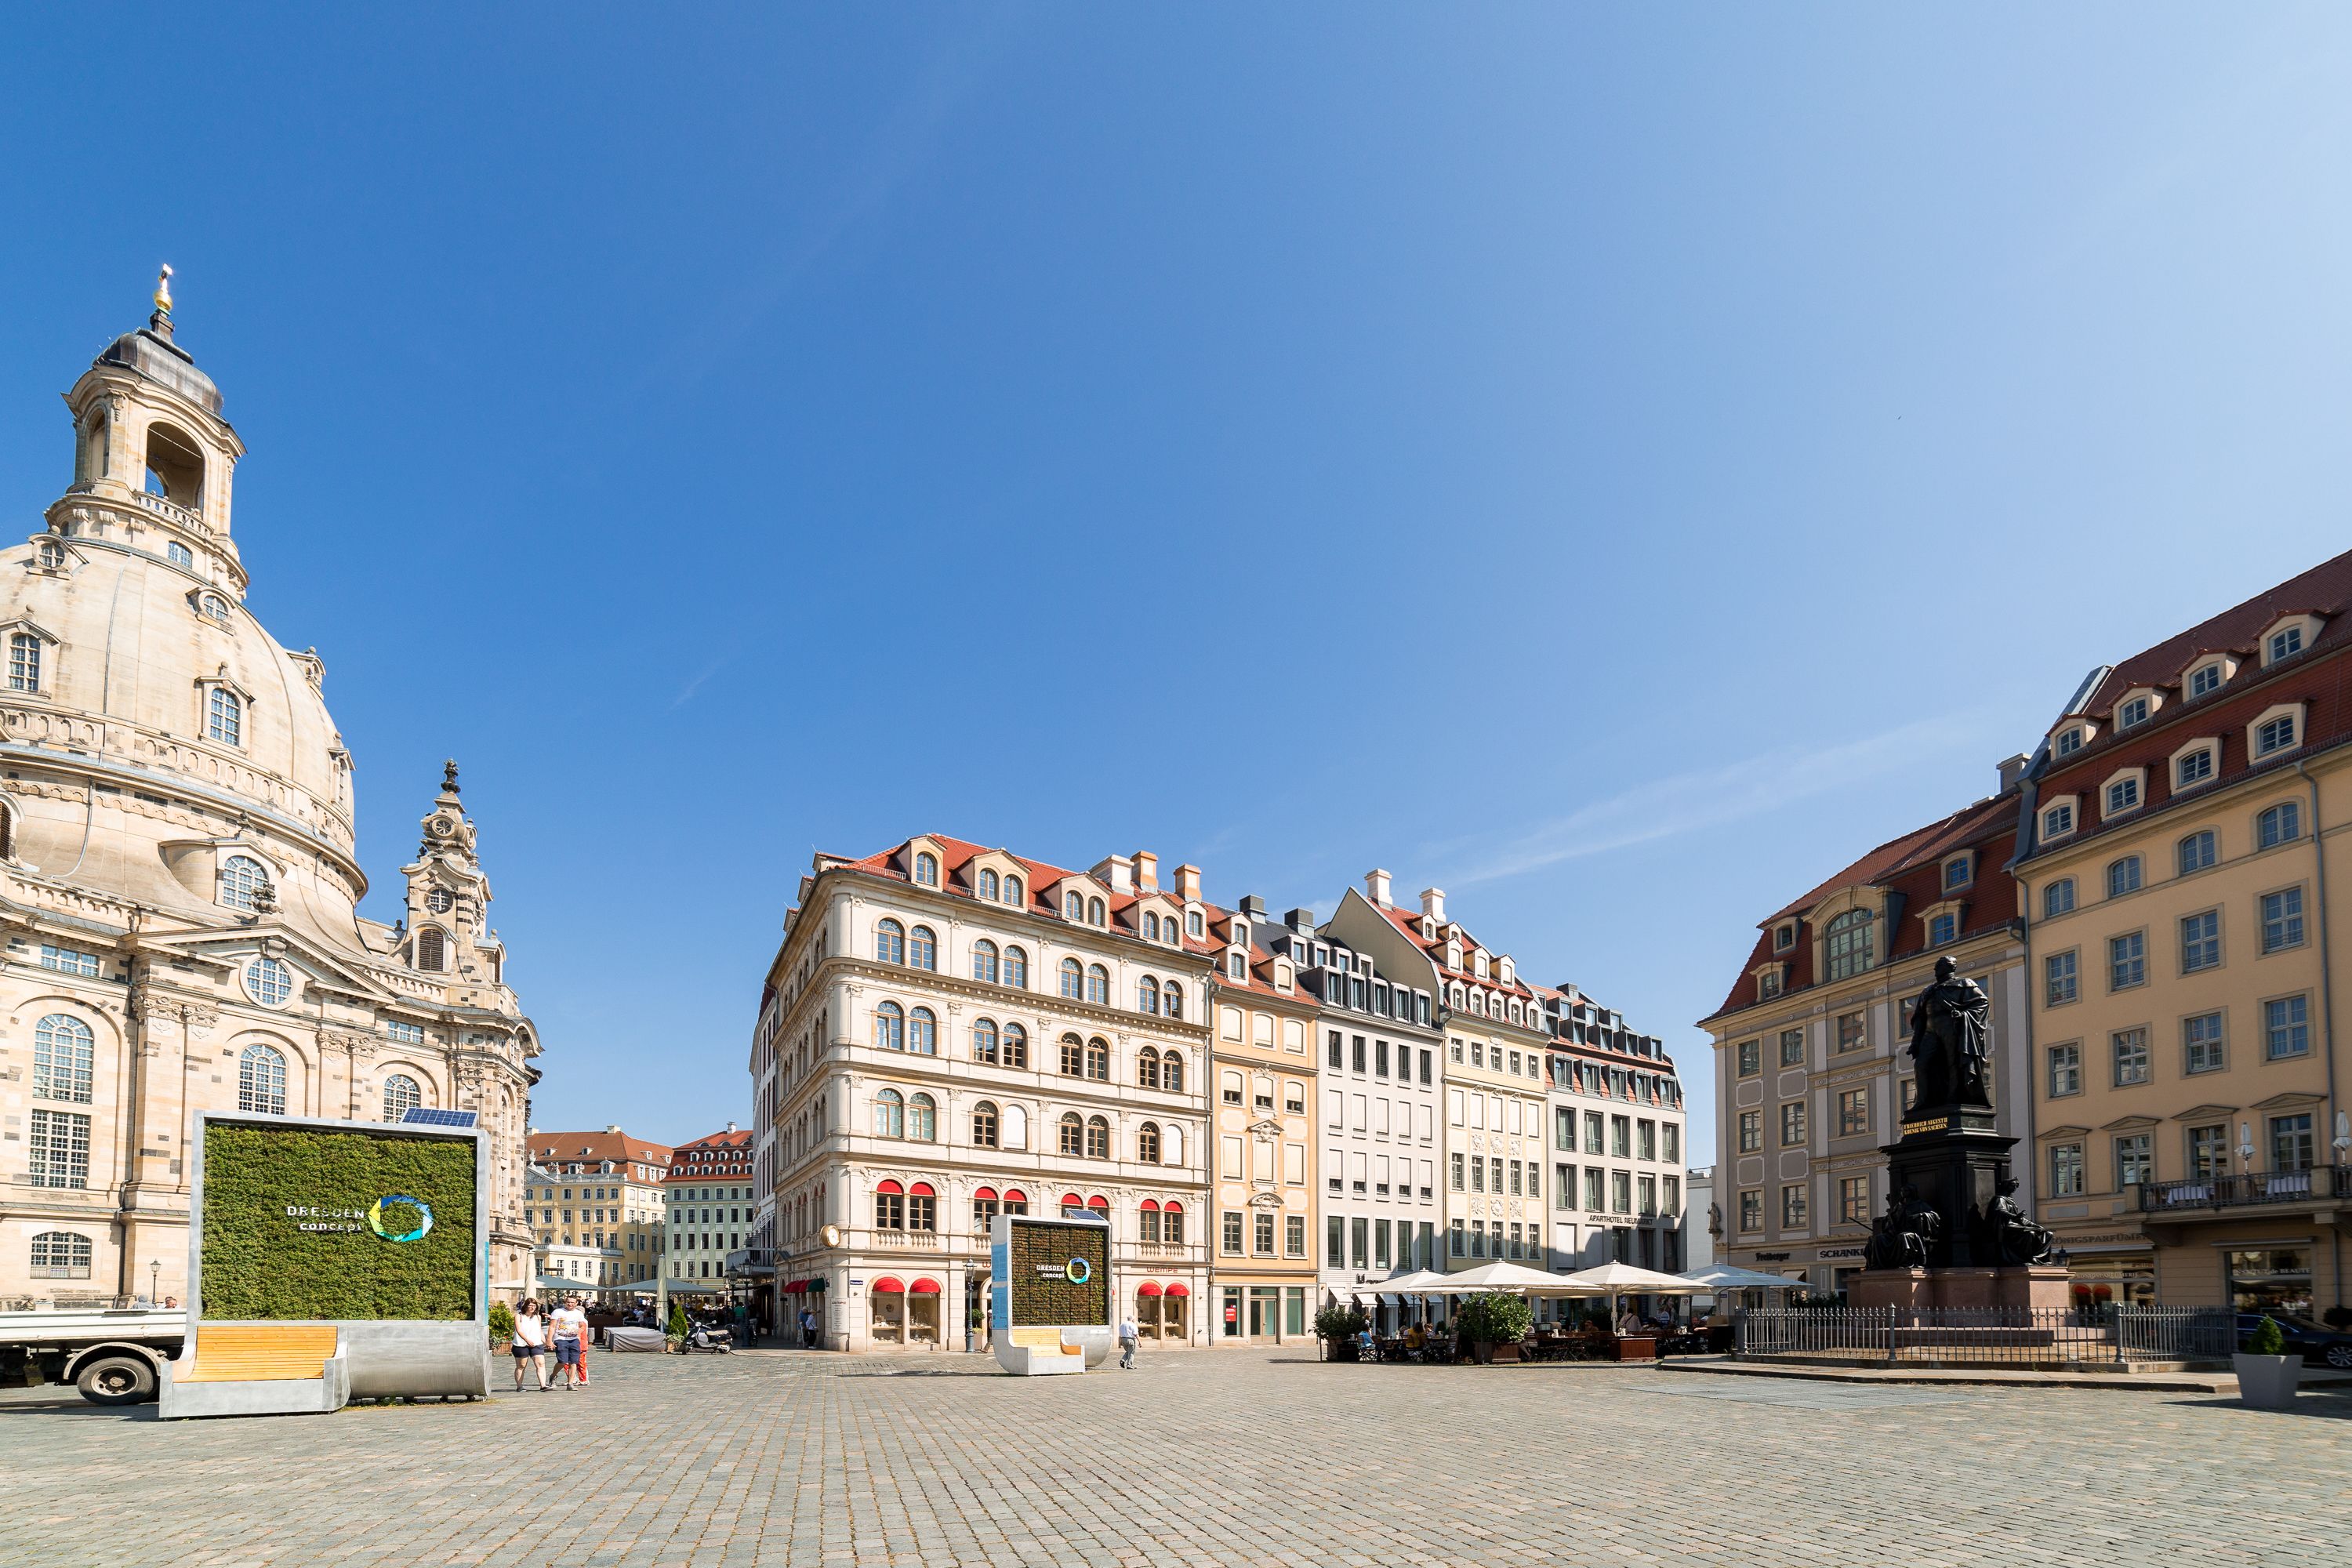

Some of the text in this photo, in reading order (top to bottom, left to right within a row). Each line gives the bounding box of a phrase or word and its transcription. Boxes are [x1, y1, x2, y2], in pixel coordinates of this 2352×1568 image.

[287, 1206, 365, 1218] DRESDEN
[1589, 1214, 1653, 1225] APARTHOTEL NEUMARKT
[299, 1222, 362, 1232] concept
[2051, 1233, 2147, 1244] KÖNIGSPARFÜMER
[1755, 1252, 1790, 1261] Freiberger
